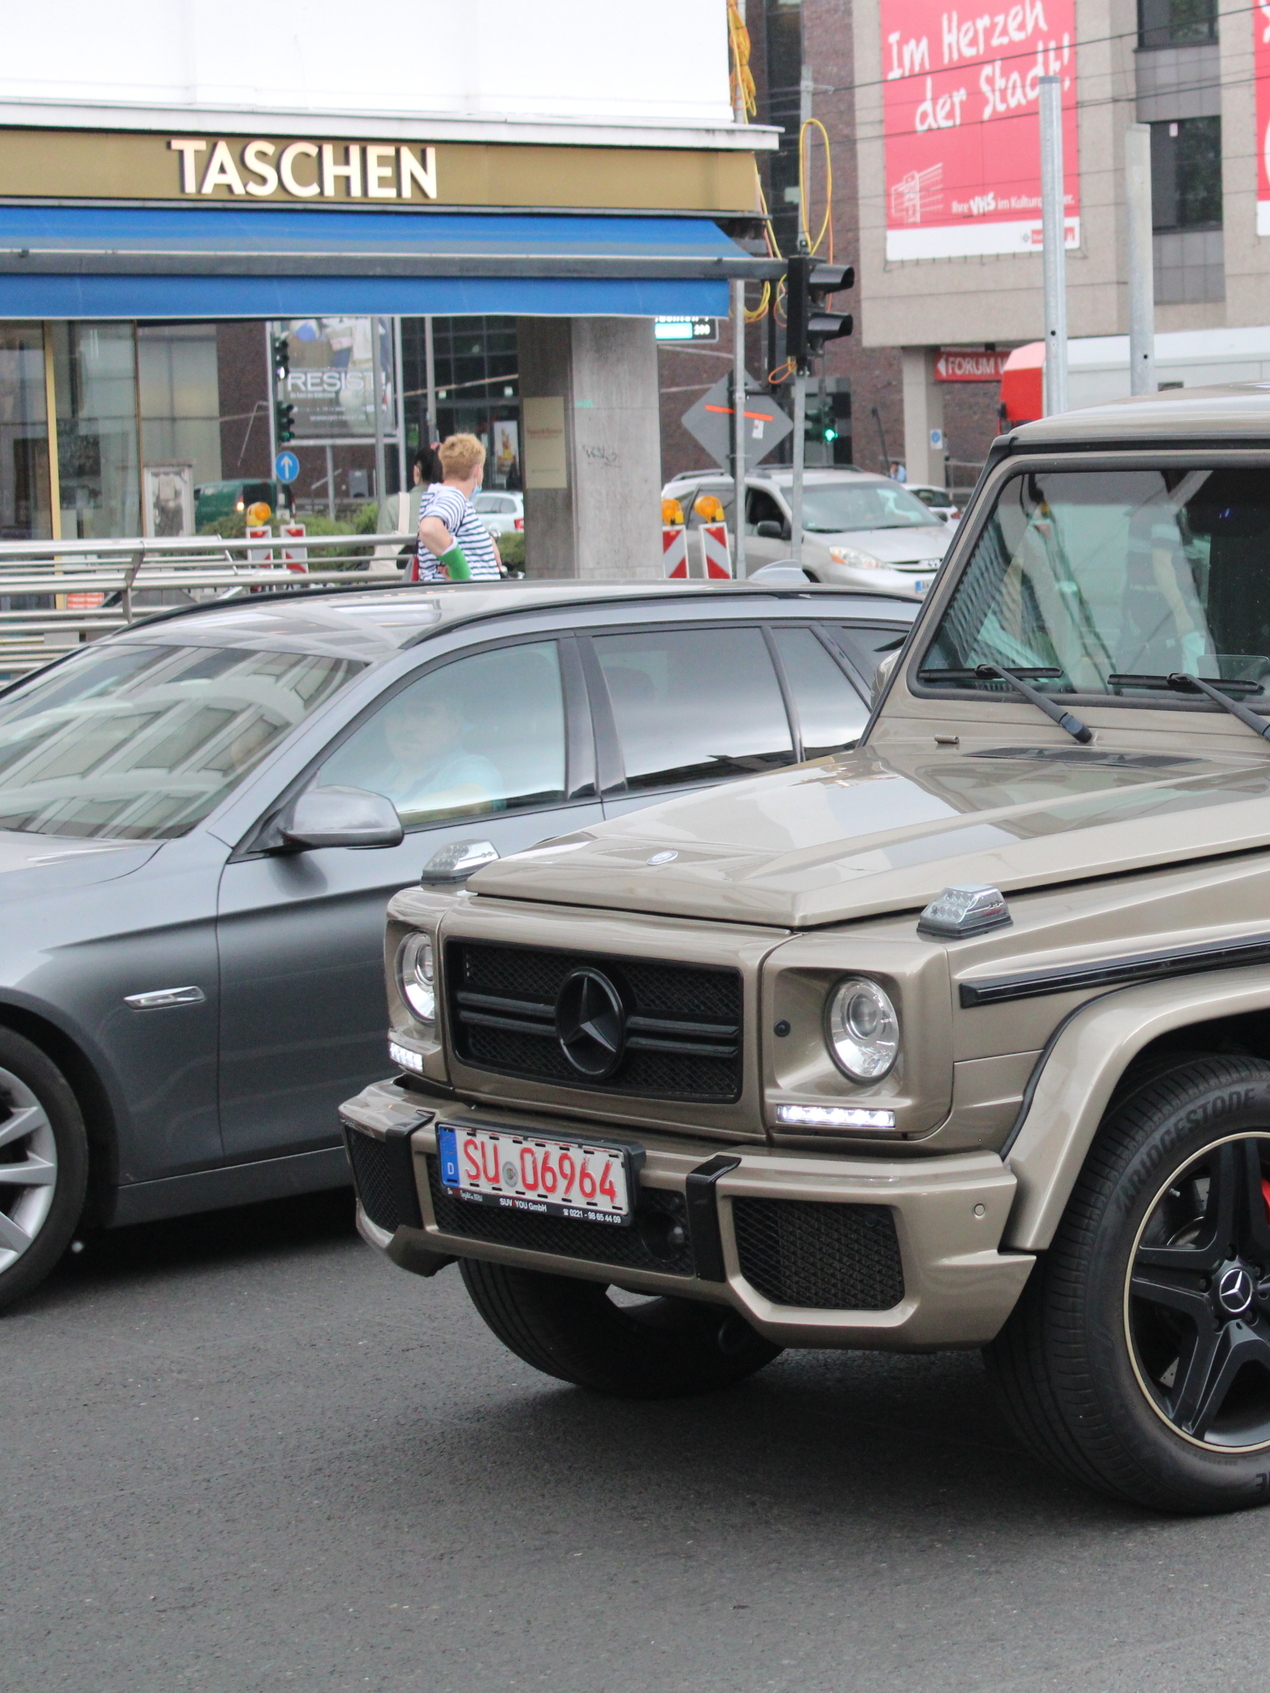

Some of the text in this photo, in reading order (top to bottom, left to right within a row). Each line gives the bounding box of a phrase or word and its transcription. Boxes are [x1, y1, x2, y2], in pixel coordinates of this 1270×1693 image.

[888, 0, 1048, 81] Im Herzen
[915, 32, 1070, 134] der Stadt!
[168, 139, 437, 199] TASCHEN
[952, 200, 969, 213] Ihre
[970, 191, 996, 215] VHS
[948, 357, 995, 375] FORUM
[447, 1138, 617, 1204] D SU 06964
[1115, 1088, 1256, 1212] BRIDGESTONE
[528, 1202, 547, 1213] GmbH
[569, 1209, 583, 1218] 0221
